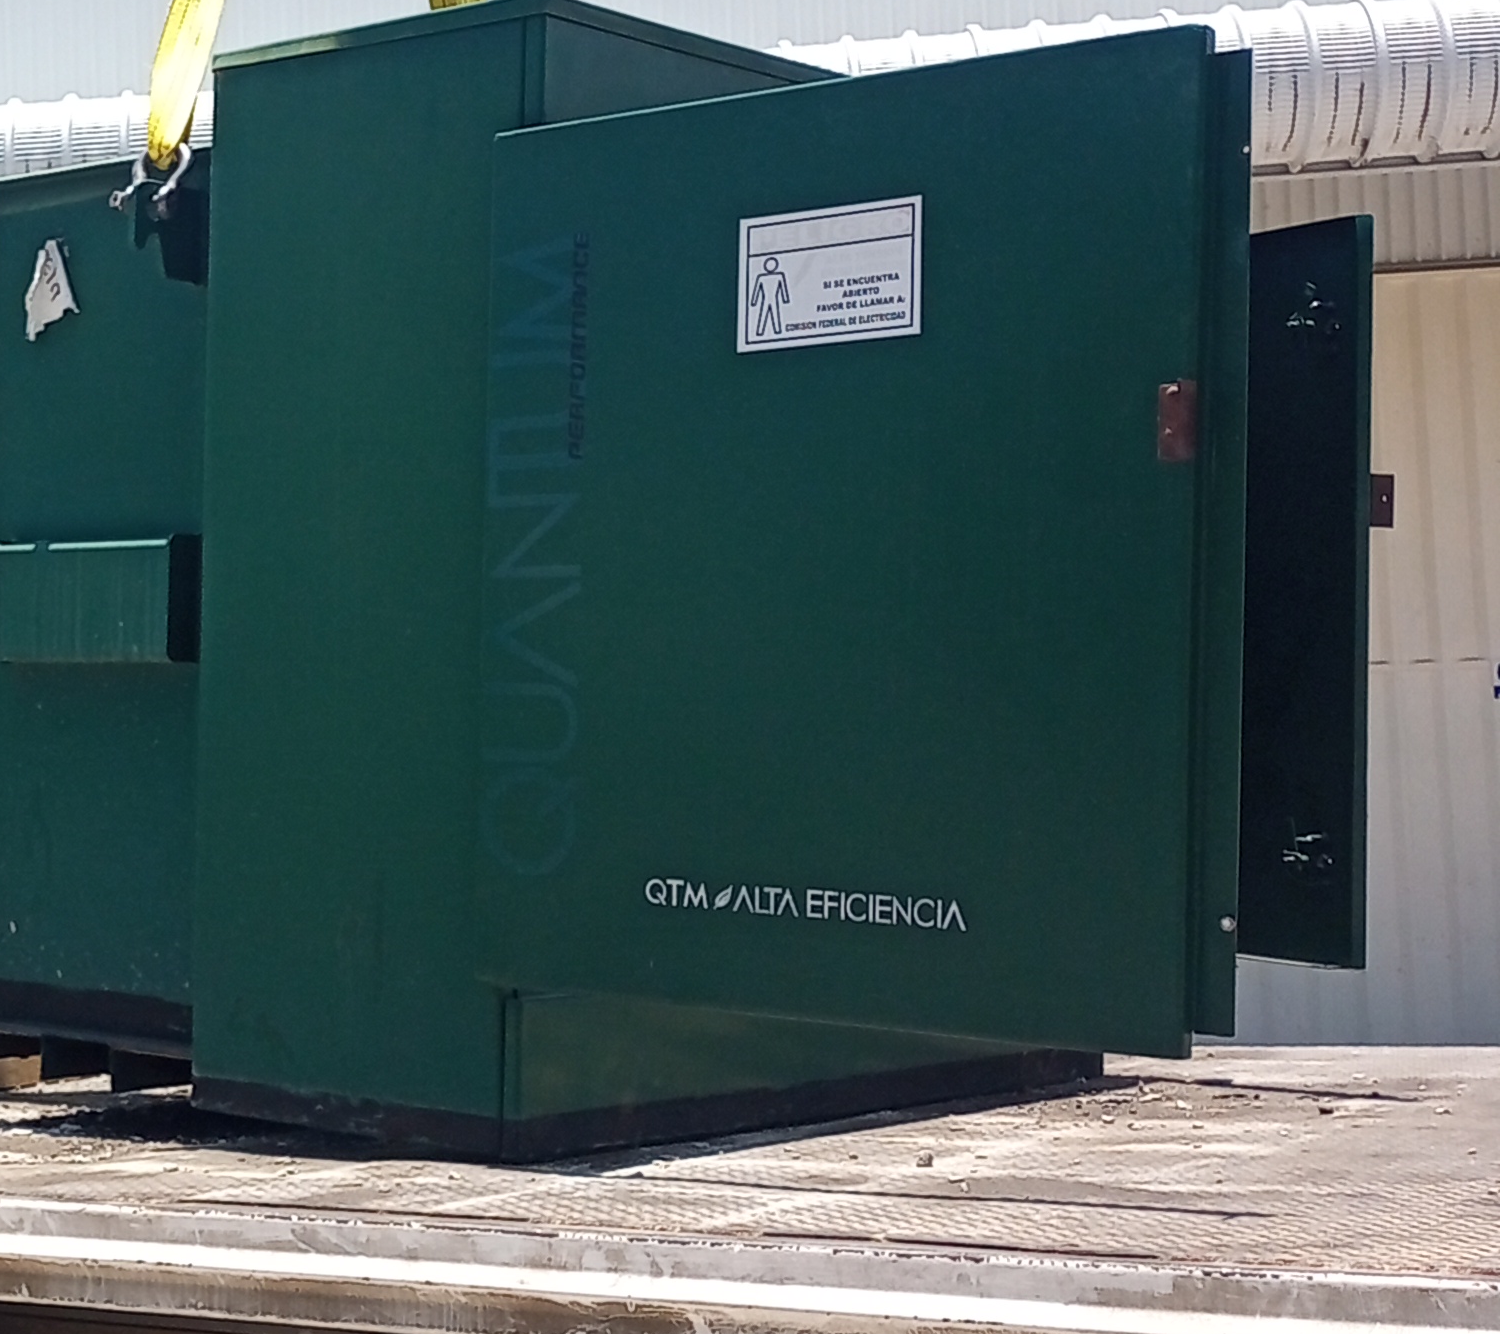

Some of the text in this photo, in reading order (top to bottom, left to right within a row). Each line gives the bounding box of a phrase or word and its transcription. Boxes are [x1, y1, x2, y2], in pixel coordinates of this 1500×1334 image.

[753, 211, 909, 251] PELIGRO
[823, 272, 900, 289] SI SE ENCUENTRA
[842, 287, 880, 298] ABIERTO
[816, 302, 844, 312] FAVOR
[846, 300, 857, 309] DE
[860, 296, 895, 308] LLAMAR
[819, 317, 847, 328] FEDERAL
[848, 316, 857, 325] DE
[568, 232, 590, 460] PERFORMANCE
[480, 234, 583, 876] QUANTUM
[645, 878, 967, 932] QTM ALTA EFICIENCIA
